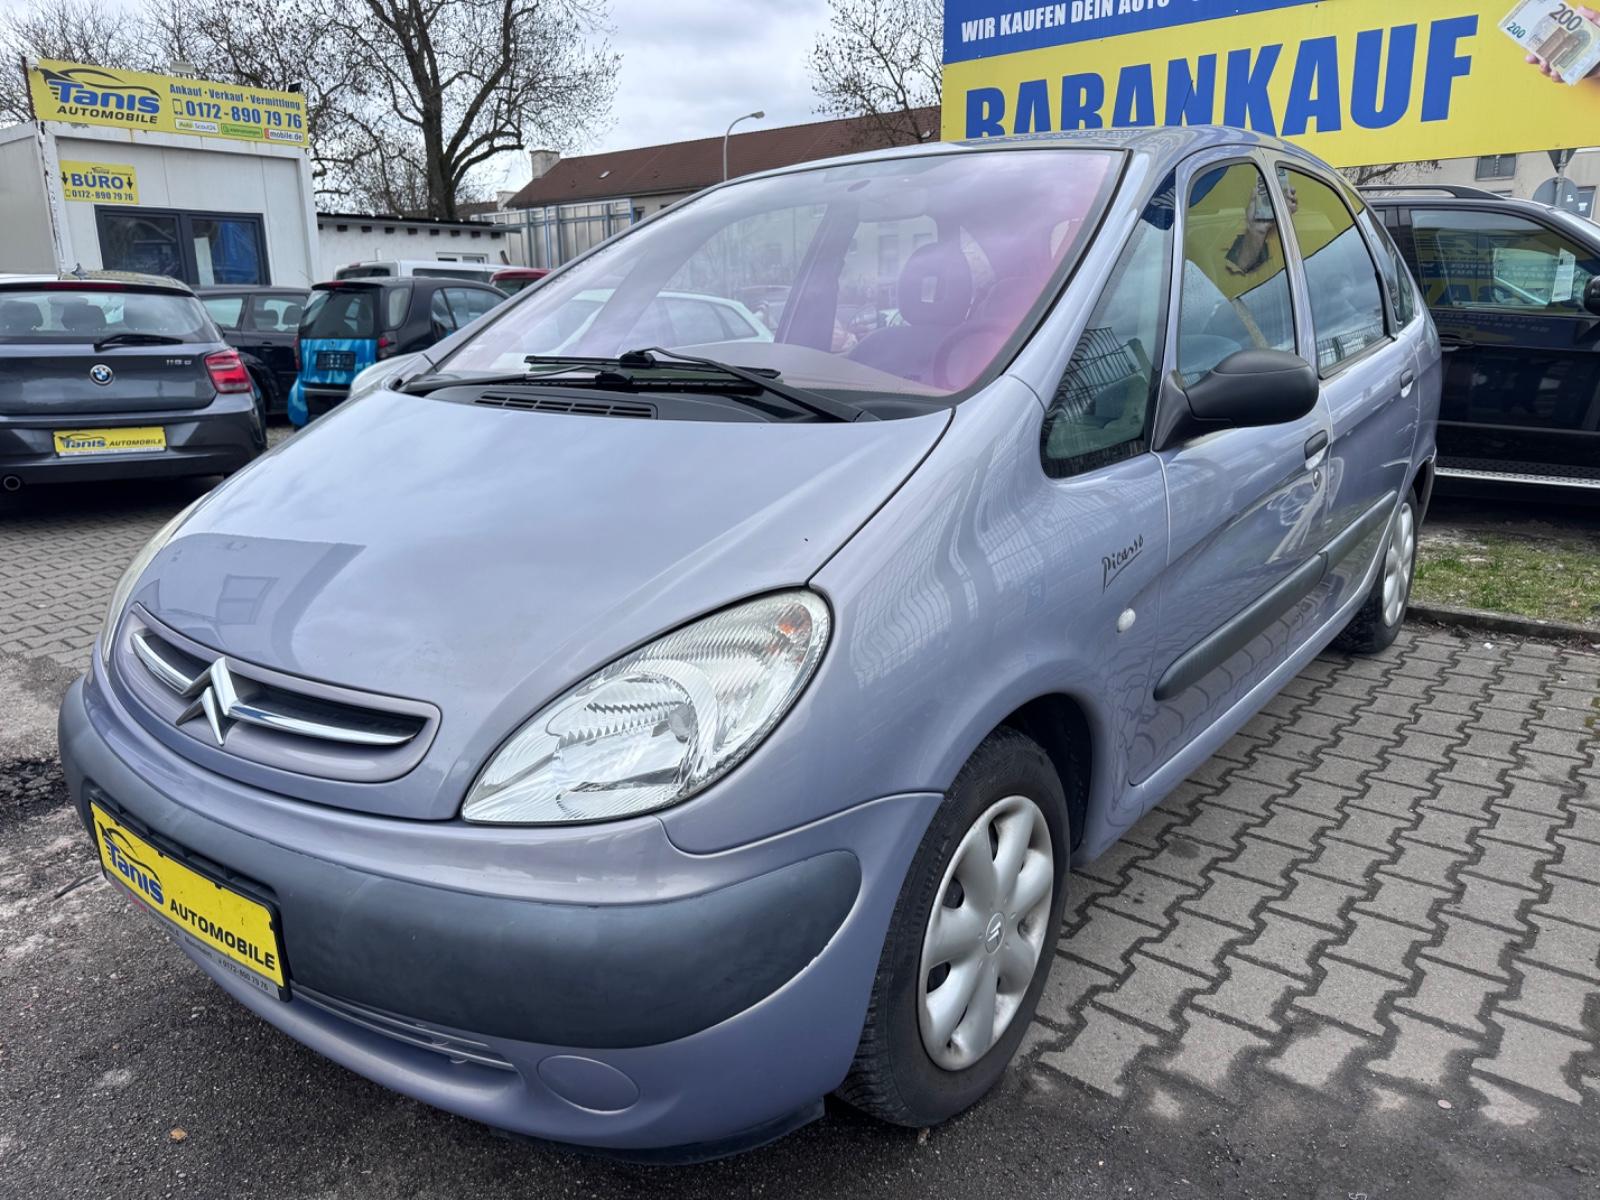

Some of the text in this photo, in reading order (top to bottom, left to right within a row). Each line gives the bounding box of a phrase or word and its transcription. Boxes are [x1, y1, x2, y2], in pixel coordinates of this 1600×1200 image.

[961, 16, 995, 42] WIR
[1000, 6, 1065, 36] KAUFEN
[1071, 0, 1114, 23] DEIN
[1506, 22, 1526, 38] 200
[1548, 3, 1582, 31] 200
[966, 15, 1478, 139] BARANKAUF
[48, 80, 160, 114] Tanis
[170, 84, 300, 110] Ankauf Verkauf Vermittlung
[57, 105, 158, 124] AUTOMOBILE
[264, 110, 282, 126] 79
[285, 113, 303, 129] 76
[71, 171, 123, 190] BÜRO
[109, 439, 163, 447] AUTOMOBILE
[104, 838, 164, 905] Tanis
[170, 898, 275, 971] AUTOMOBILE
